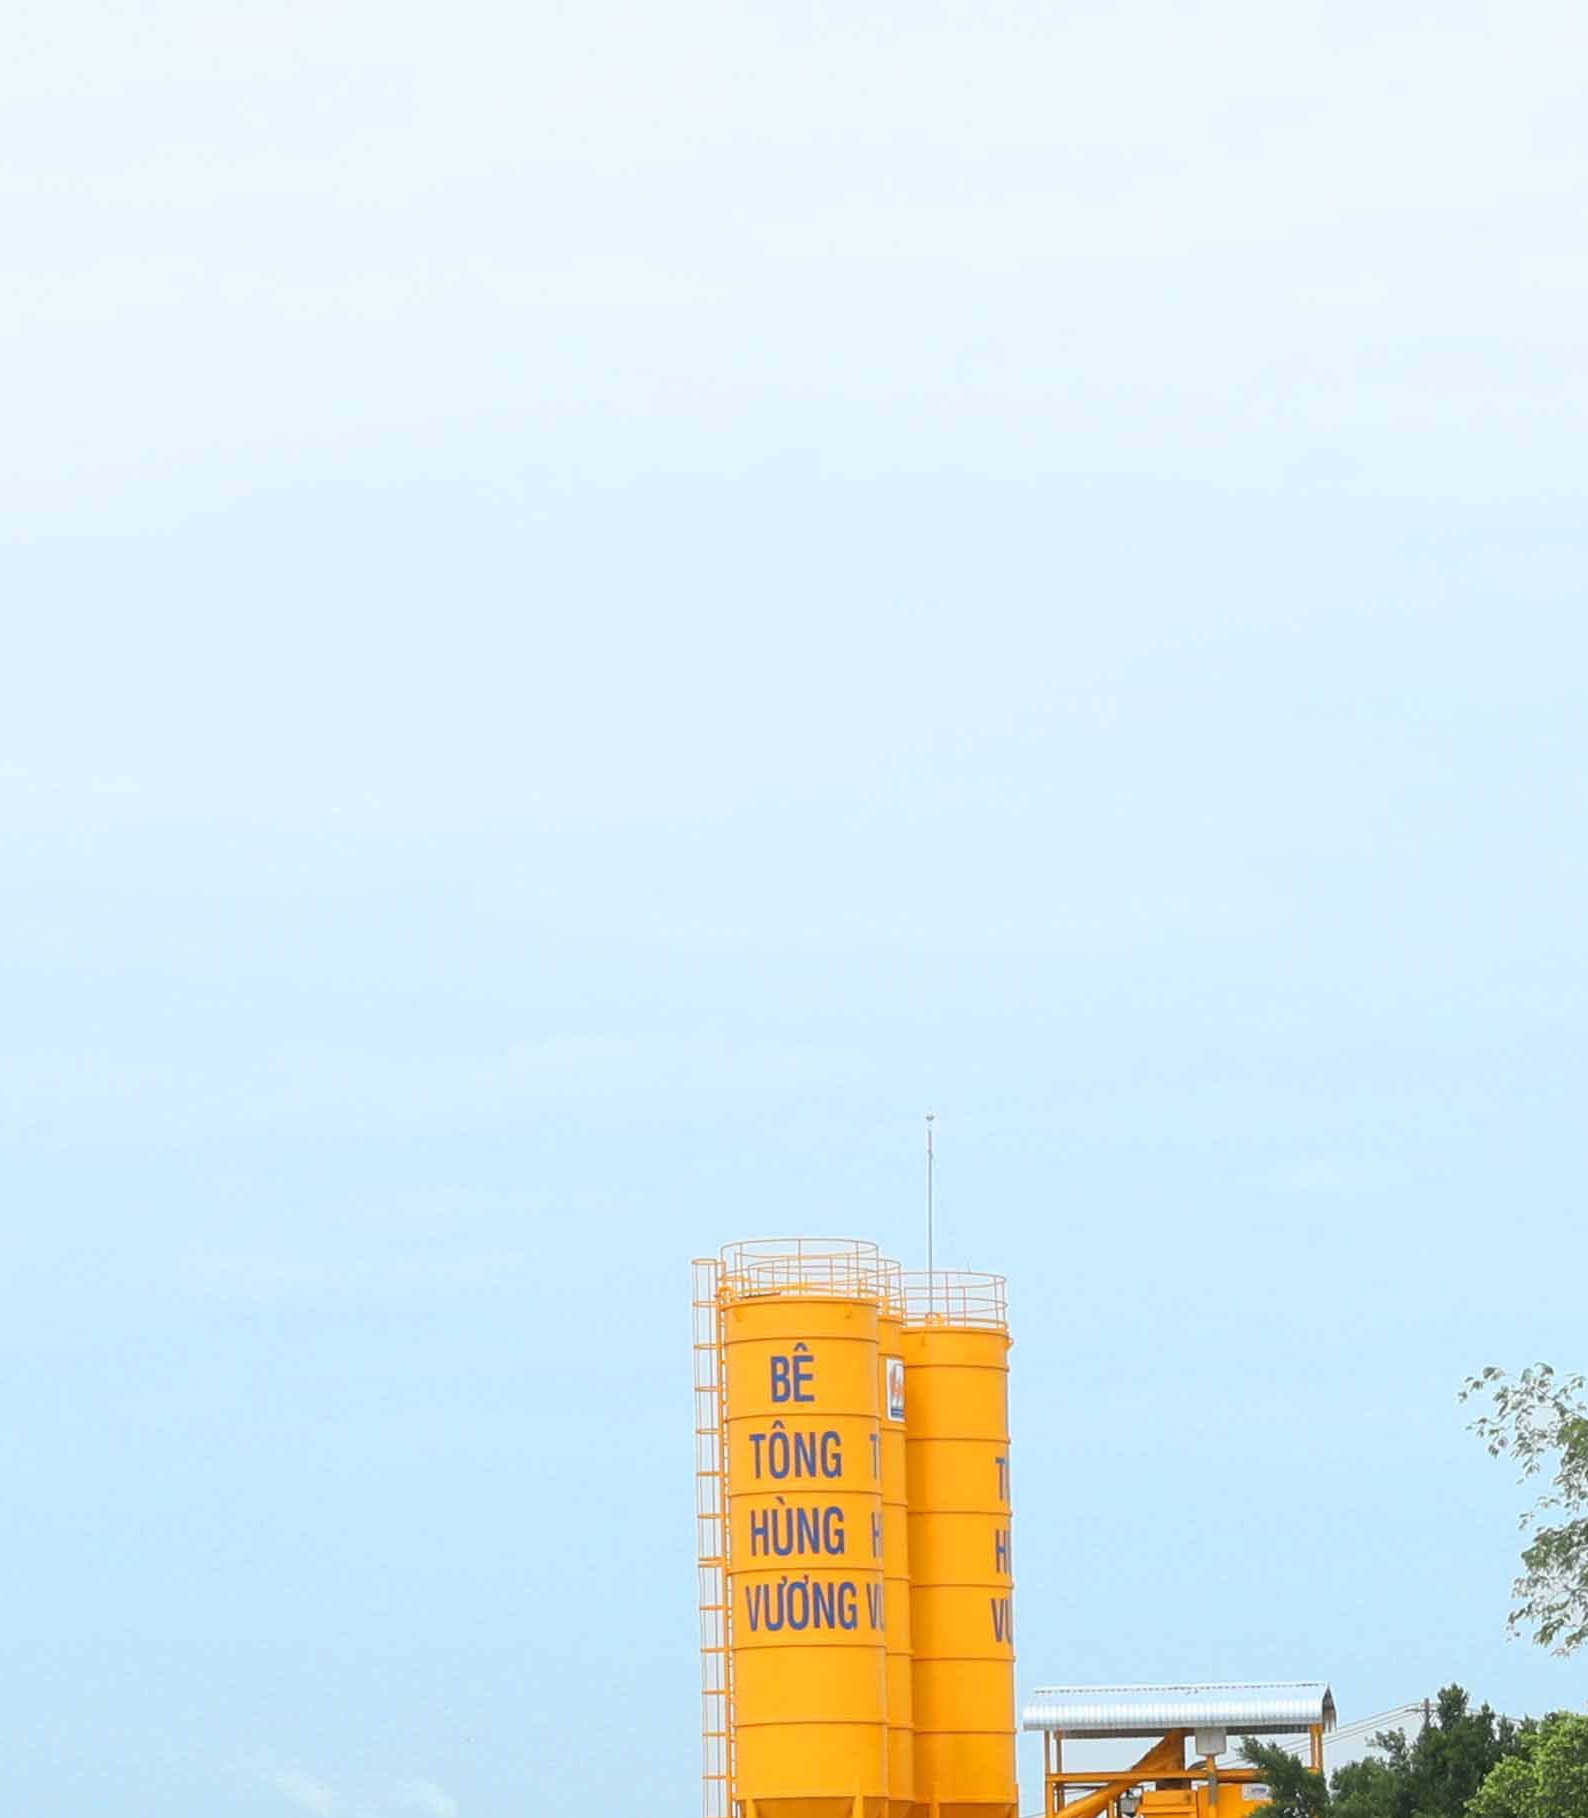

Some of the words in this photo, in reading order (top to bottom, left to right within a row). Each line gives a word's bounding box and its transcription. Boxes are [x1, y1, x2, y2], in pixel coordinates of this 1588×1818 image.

[770, 1342, 815, 1403] BÊ
[749, 1420, 842, 1479] TÔNG
[751, 1496, 845, 1557] HÙNG
[745, 1574, 858, 1632] VƯƠNG
